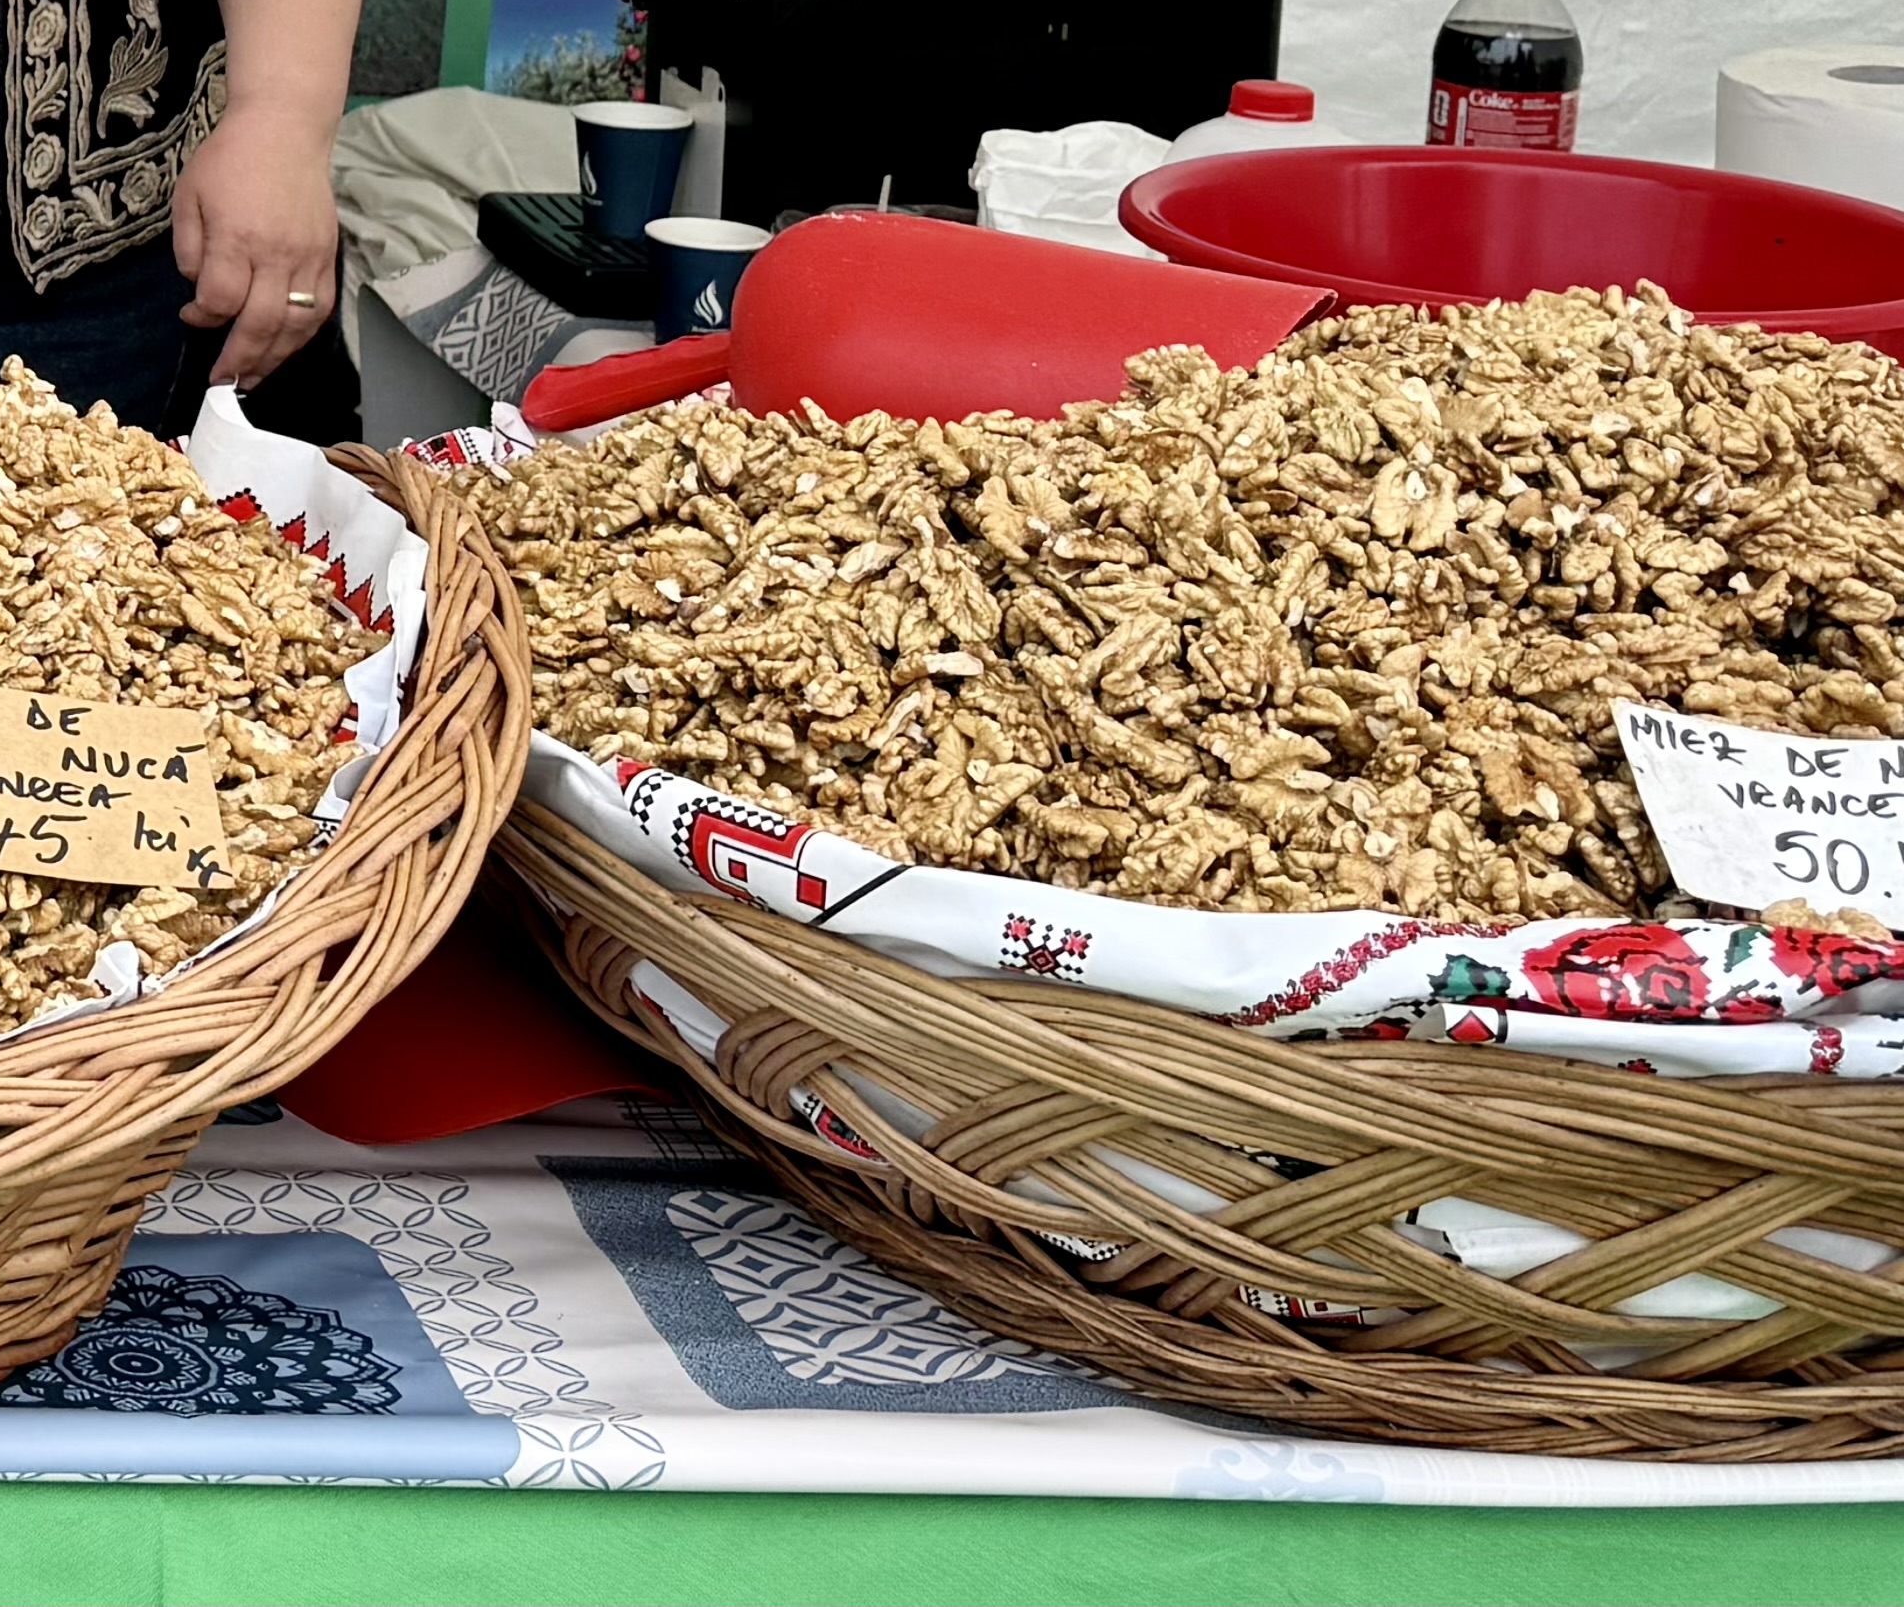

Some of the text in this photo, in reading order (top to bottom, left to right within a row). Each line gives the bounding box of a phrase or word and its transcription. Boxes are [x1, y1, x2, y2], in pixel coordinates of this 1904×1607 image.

[26, 698, 93, 735] DE
[1629, 713, 1748, 765] MIEZ
[1785, 746, 1849, 778] DE
